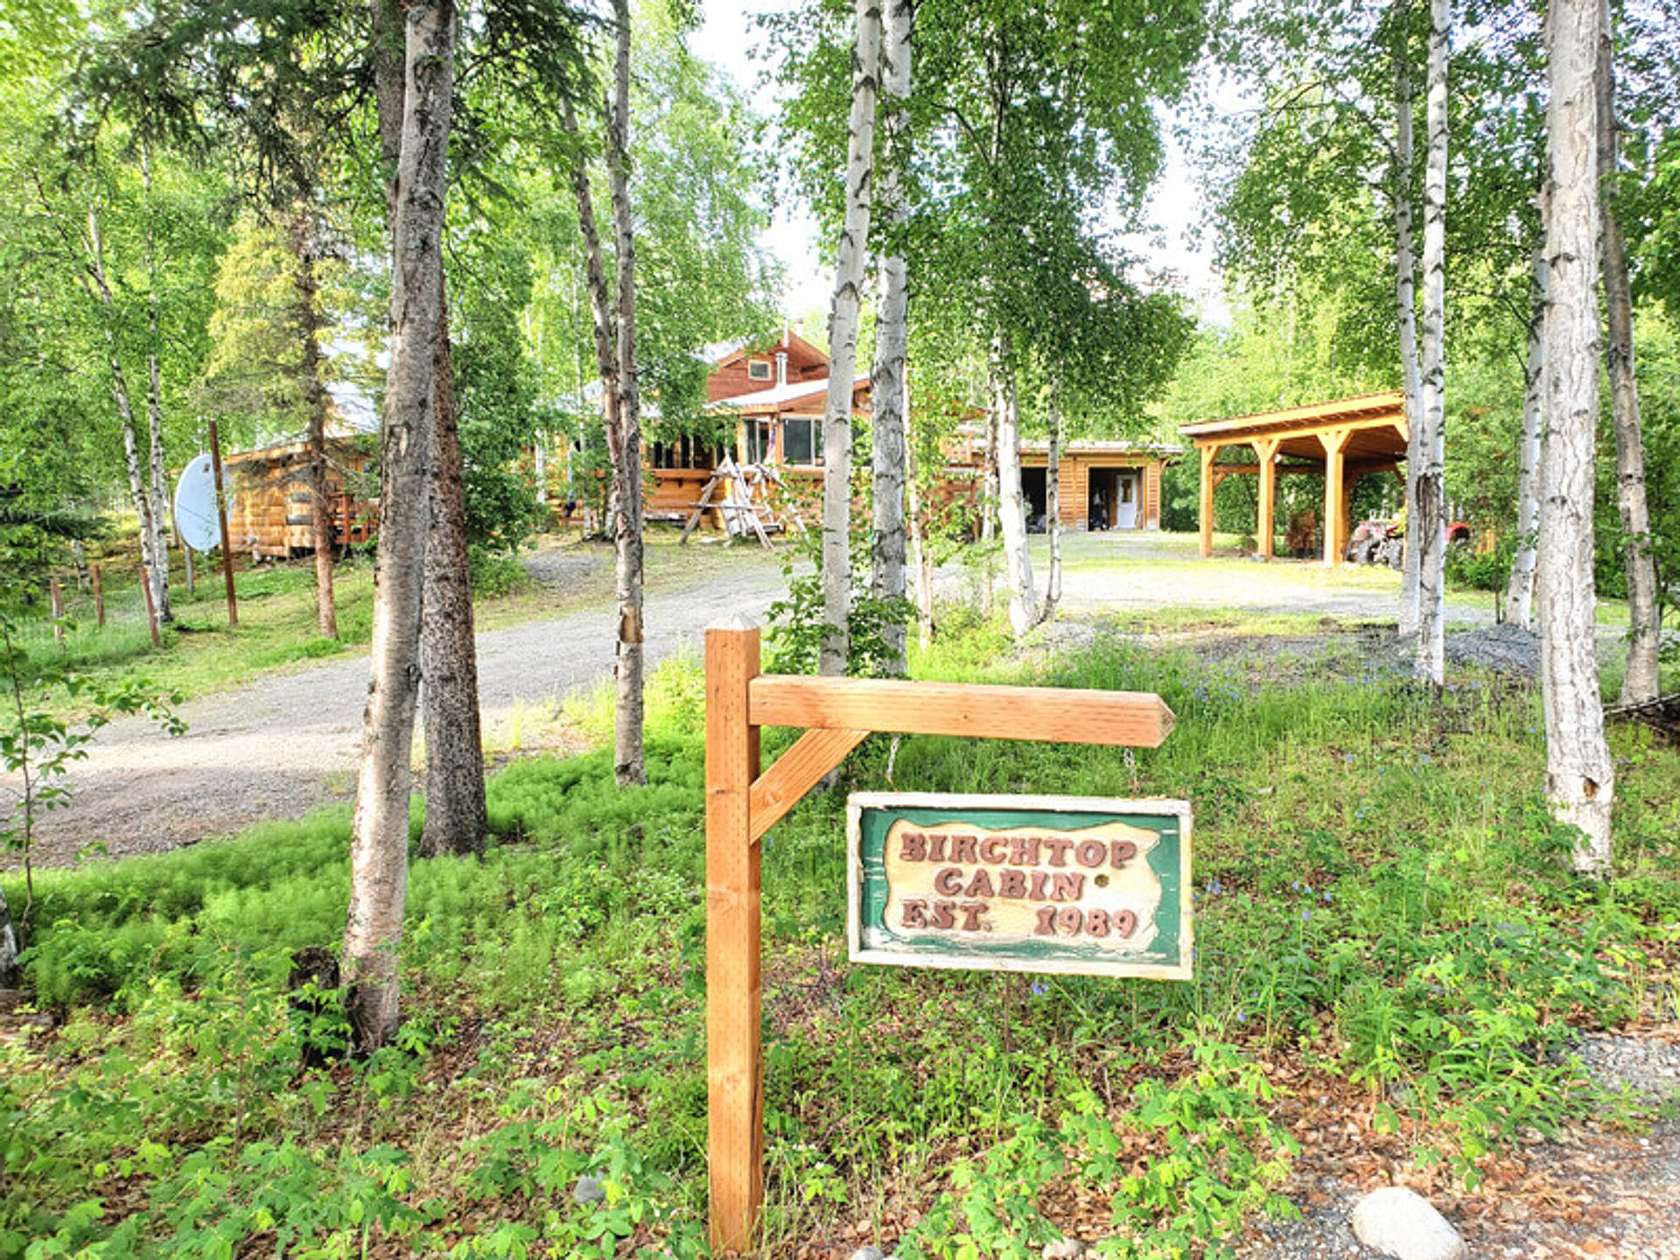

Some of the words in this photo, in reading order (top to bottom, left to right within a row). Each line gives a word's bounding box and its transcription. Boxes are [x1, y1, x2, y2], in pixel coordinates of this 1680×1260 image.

[899, 833, 1137, 869] BIRCHTOP
[934, 867, 1086, 901] CABIN
[901, 899, 993, 932] EST.
[1034, 905, 1137, 939] 1989
